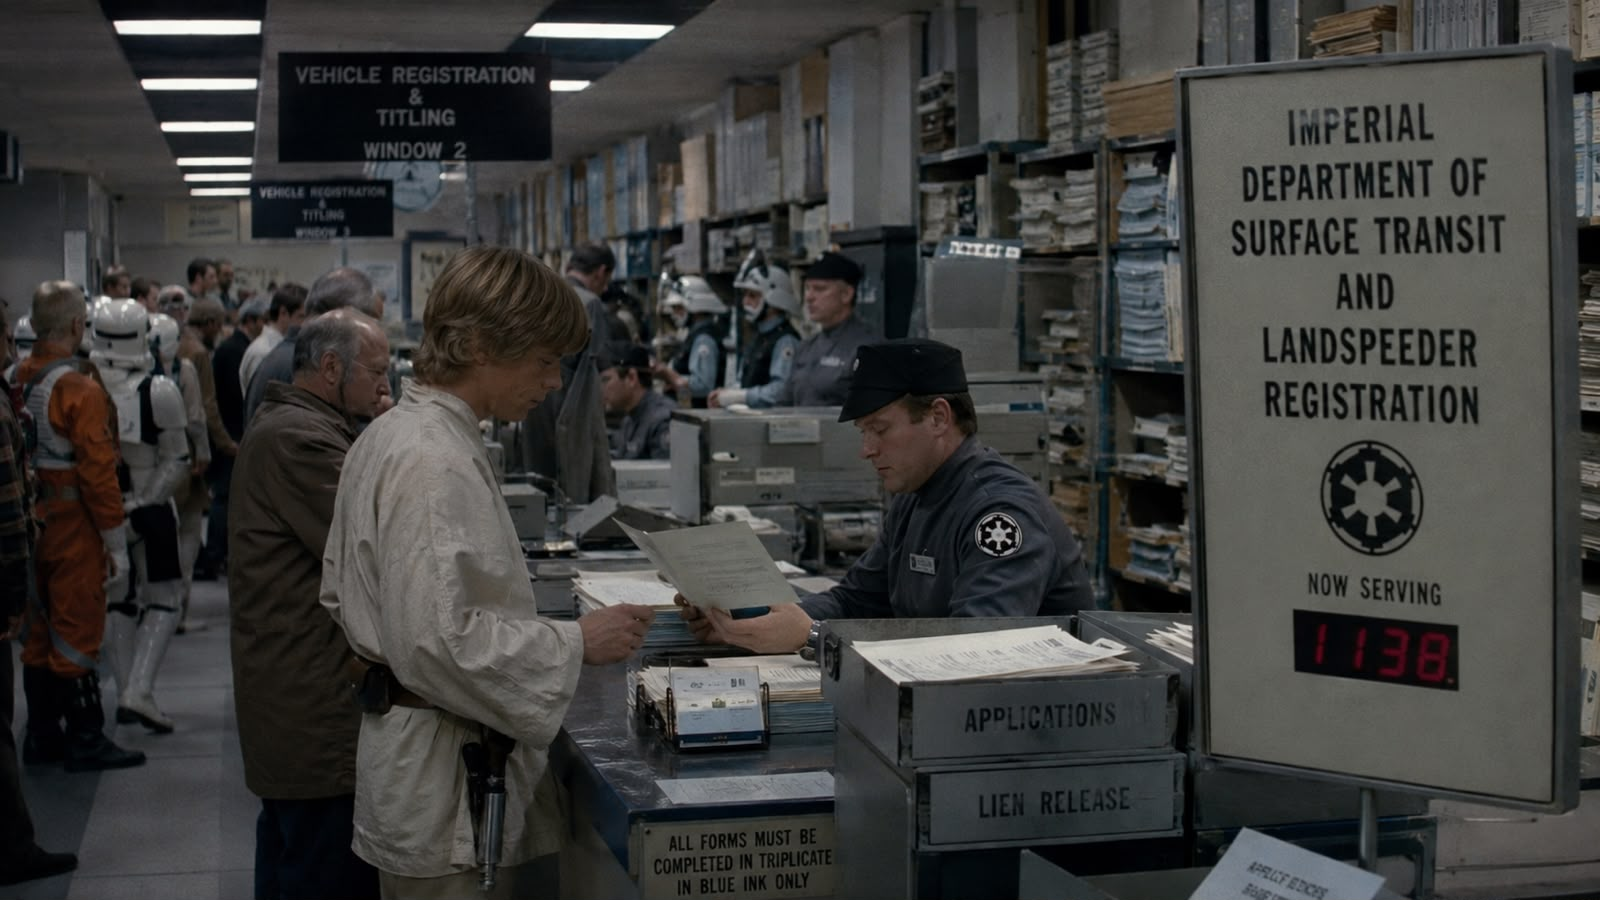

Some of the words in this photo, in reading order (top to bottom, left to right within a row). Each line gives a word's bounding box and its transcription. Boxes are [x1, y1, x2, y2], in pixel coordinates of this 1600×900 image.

[296, 66, 382, 84] VEHICLE
[392, 66, 536, 84] REGISTRATION
[408, 88, 423, 106] &
[376, 108, 456, 127] TITLING
[1288, 103, 1434, 146] IMPERIAL
[363, 141, 443, 160] WINDOW
[454, 141, 467, 160] 2
[259, 186, 305, 199] VEHICLE
[310, 185, 387, 198] REGISTRATION
[1243, 160, 1433, 202] DEPARTMENT
[1450, 157, 1487, 197] OF
[302, 209, 345, 222] TITLING
[1231, 217, 1359, 256] SURFACE
[1374, 215, 1505, 255] TRANSIT
[1336, 273, 1394, 310] AND
[1263, 327, 1477, 368] LANDSPEEDER
[1264, 381, 1479, 425] REGISTRATION
[1308, 573, 1348, 598] NOW
[1360, 577, 1441, 606] SERVING
[965, 702, 1116, 733] APPLICATIONS
[979, 792, 1025, 818] LIEN
[1041, 787, 1130, 816] RELEASE
[669, 835, 693, 852] ALL
[701, 832, 747, 850] FORMS
[755, 830, 792, 847] MUST
[800, 828, 817, 844] BE
[654, 855, 733, 875] COMPLETED
[740, 853, 753, 870] IN
[760, 849, 832, 869] TRIPLICATE
[678, 879, 691, 896] IN
[701, 876, 735, 894] BLUE
[744, 874, 767, 892] INK
[776, 871, 810, 890] ONLY
